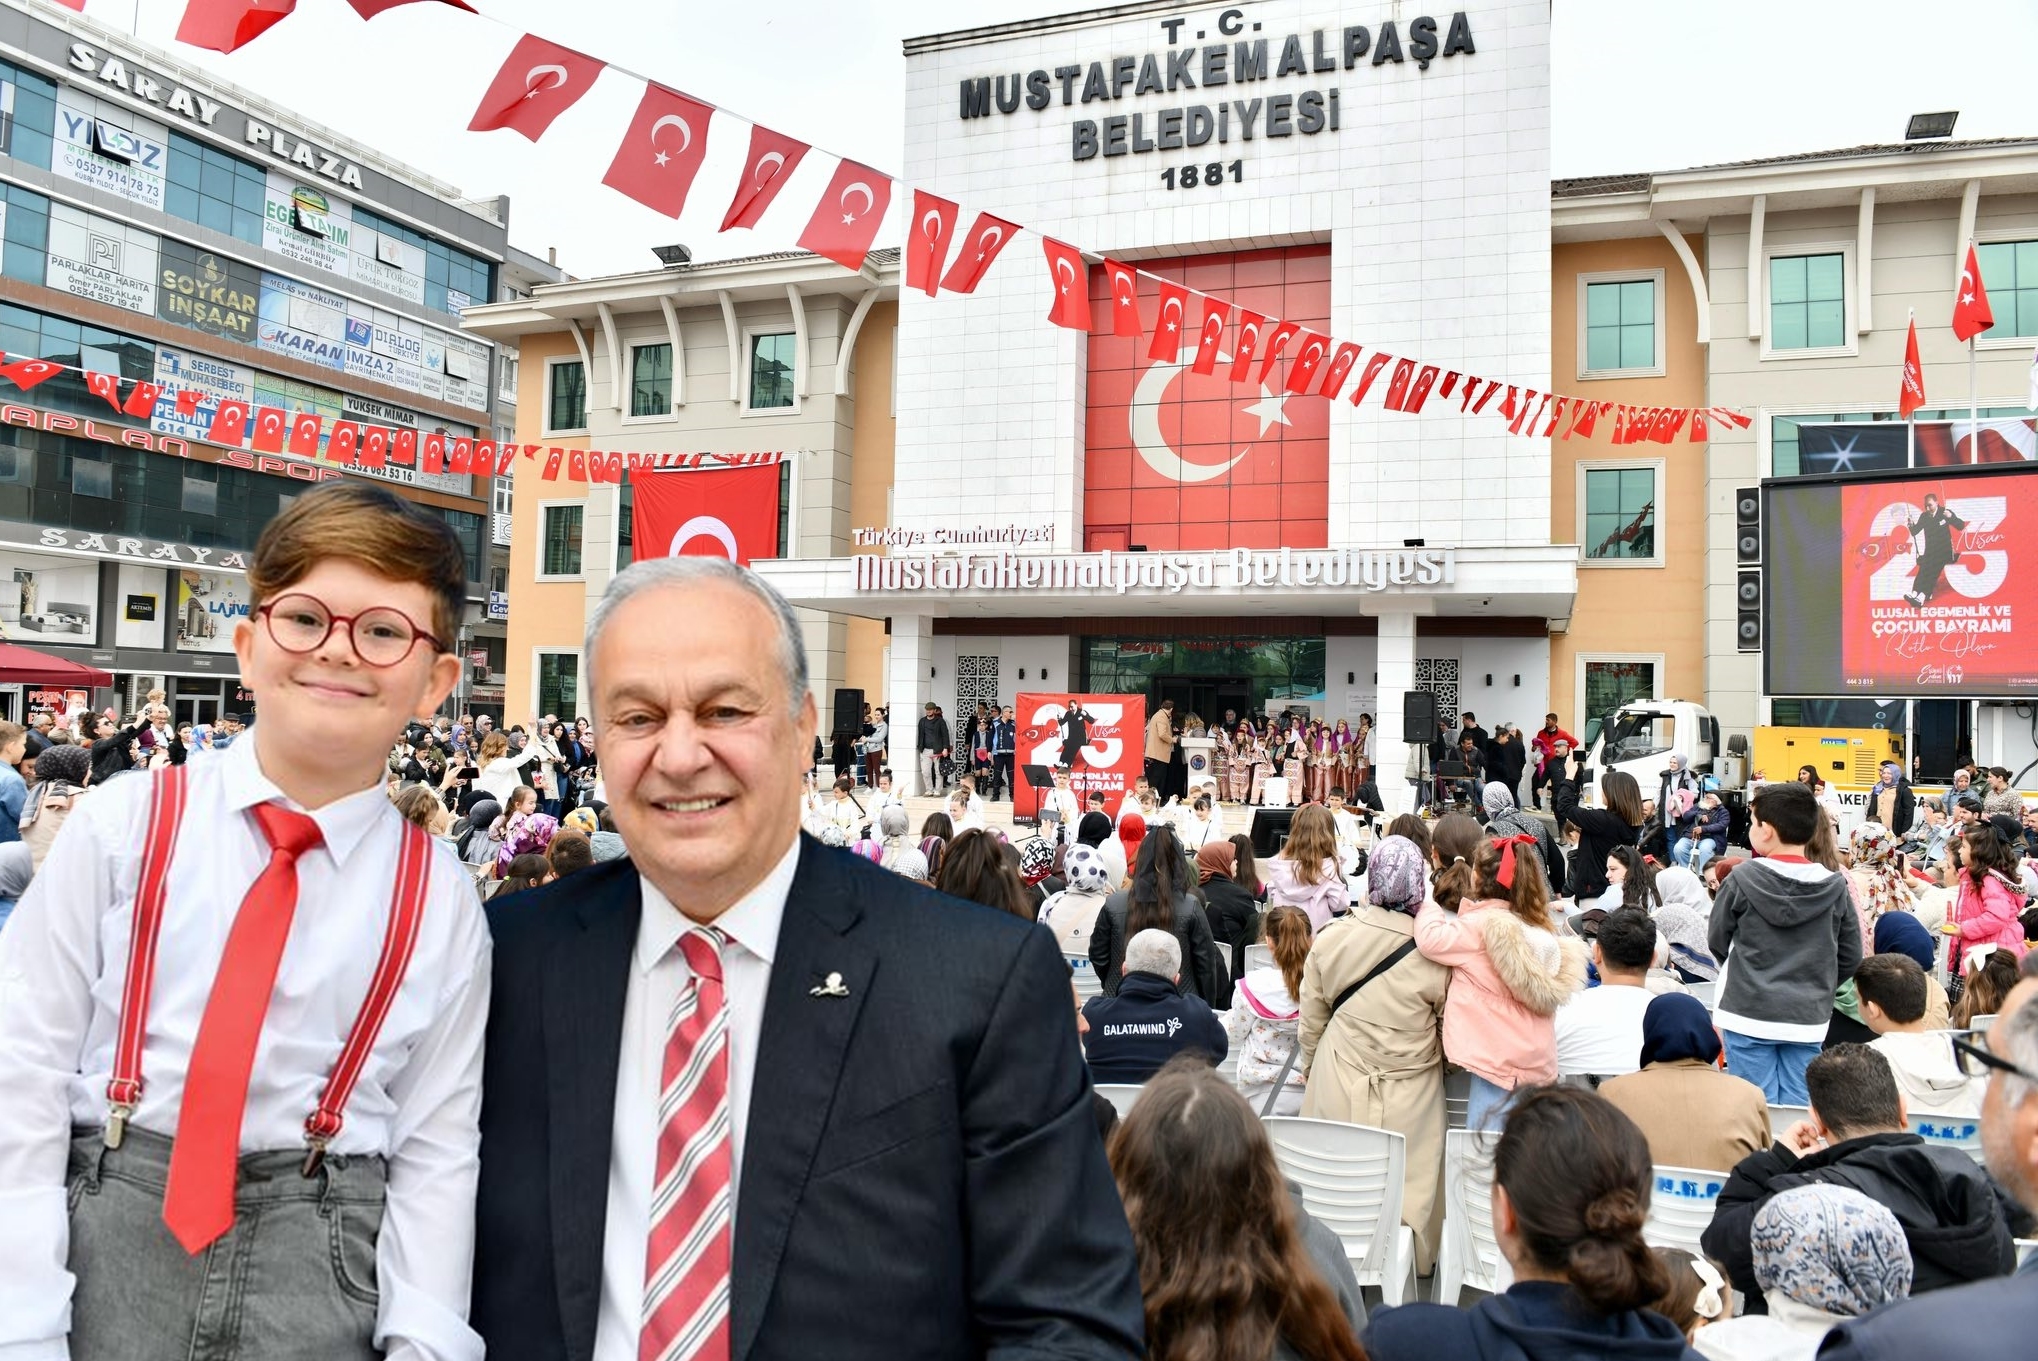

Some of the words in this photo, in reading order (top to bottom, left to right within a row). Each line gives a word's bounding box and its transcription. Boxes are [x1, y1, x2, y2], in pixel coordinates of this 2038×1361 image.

[959, 12, 1476, 119] MUSTAFAKEMALPAŞA
[69, 43, 222, 125] SARAY
[245, 119, 363, 190] PLAZA
[1072, 88, 1340, 161] BELEDİYESİ
[76, 159, 103, 176] 0537
[107, 170, 127, 185] 914
[131, 178, 143, 191] 78
[147, 184, 159, 197] 73
[1160, 159, 1244, 191] 1881
[141, 194, 158, 206] YILDIZ
[51, 257, 111, 280] PARLAKLAR
[116, 276, 149, 293] HARİTA
[68, 274, 92, 288] Ömer
[93, 283, 143, 303] PARLAKLAR
[270, 279, 296, 293] MELAS
[69, 284, 95, 298] 0534
[97, 292, 115, 303] 557
[117, 298, 127, 307] 19
[130, 301, 140, 310] 41
[163, 269, 256, 315] SOYKAR
[169, 293, 251, 332] İNŞAAT
[274, 330, 343, 361] KARAN
[191, 359, 235, 379] SERBEST
[346, 347, 383, 371] İMZA
[387, 362, 394, 373] 2
[347, 397, 382, 417] YÜKSEK
[384, 406, 414, 425] MİMAR
[158, 421, 185, 436] 614
[389, 468, 400, 480] 53
[402, 470, 412, 482] 16
[851, 527, 924, 547] Türkiye
[933, 523, 1055, 547] Cumhuriyeti
[1870, 496, 2008, 600] 23
[851, 549, 1214, 595] Mustafakemalpaşa
[1230, 545, 1455, 592] Belediyesi
[1872, 607, 1918, 619] ULUSAL
[1921, 603, 1991, 618] EGEMENLİK
[1995, 605, 2011, 616] VE
[1872, 619, 1931, 638] ÇOCUK
[1935, 619, 2012, 633] BAYRAMI
[1031, 703, 1123, 768] 23
[1112, 773, 1124, 781] VE
[1103, 1023, 1166, 1036] GALATAWIND
